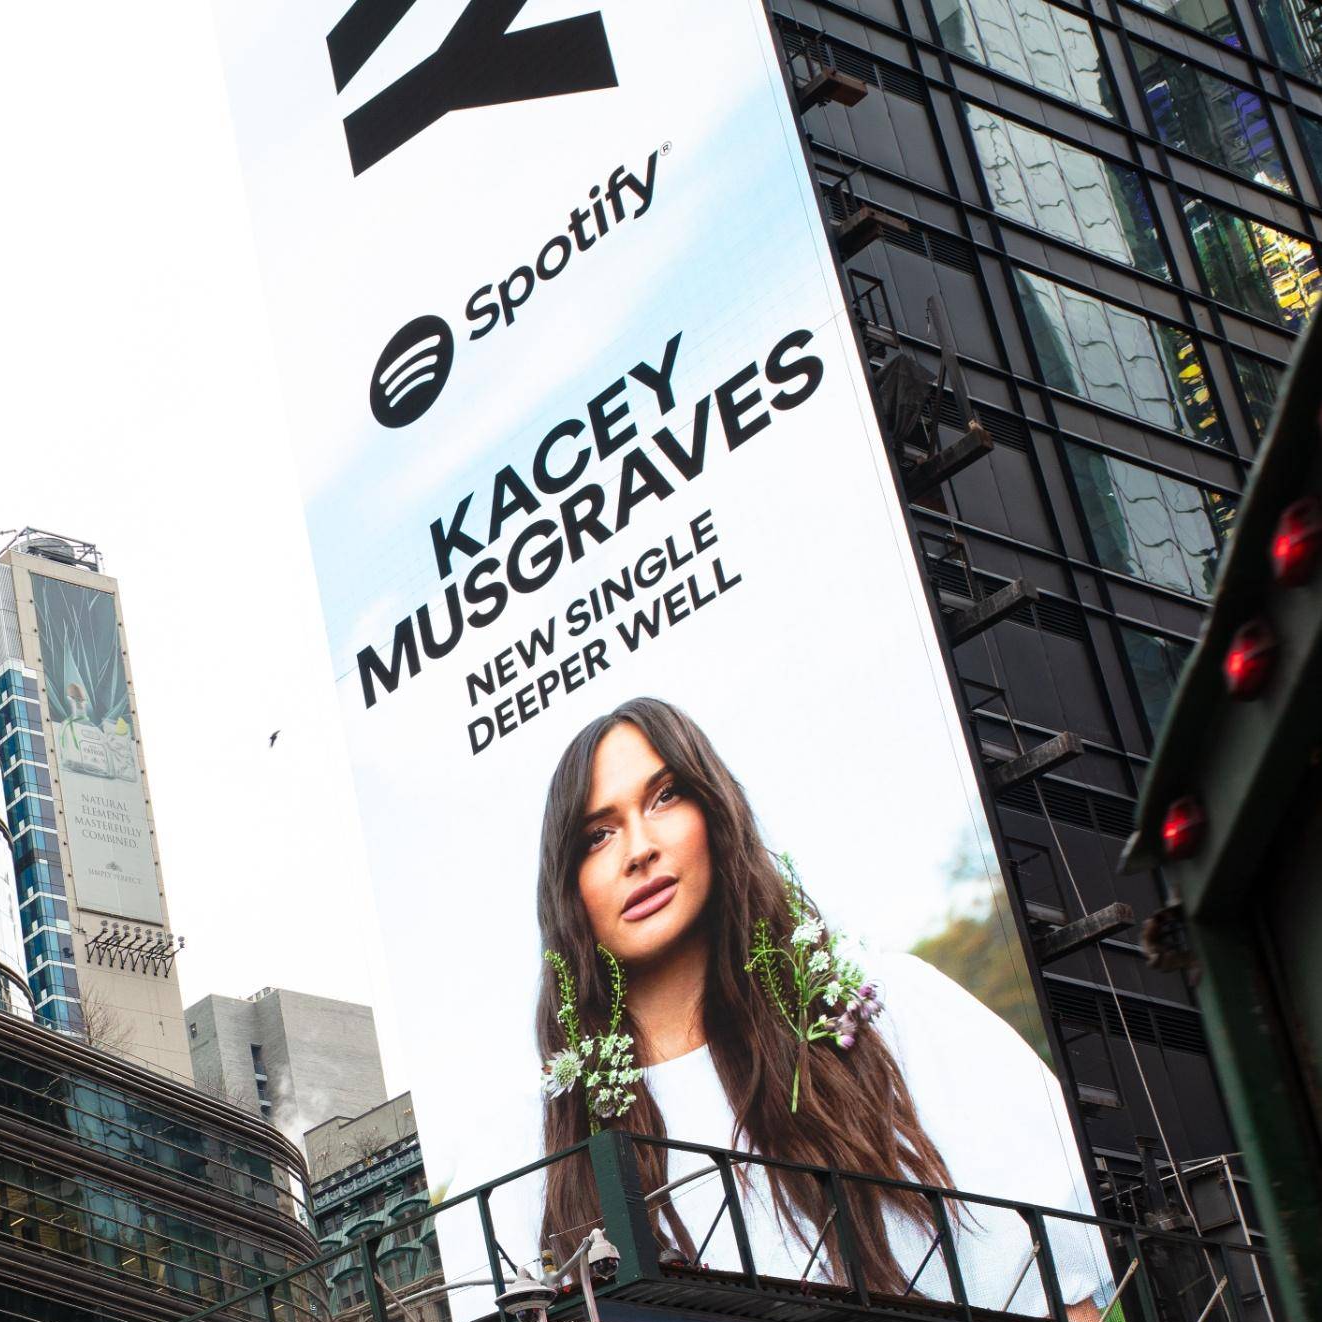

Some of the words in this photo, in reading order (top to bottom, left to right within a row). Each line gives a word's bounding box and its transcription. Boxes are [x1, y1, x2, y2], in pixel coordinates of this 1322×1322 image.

[465, 148, 659, 342] Spotify
[356, 329, 825, 710] MUSGRAVES
[429, 331, 683, 580] KACEY
[466, 616, 557, 707] NEW
[564, 509, 719, 637] SINGLE
[467, 637, 611, 756] DEEPER
[616, 559, 743, 654] WELL
[75, 816, 142, 837] MASTERFULLY
[81, 793, 129, 811] NATURAL
[82, 805, 131, 823] ELEMENTS
[82, 829, 139, 848] COMBINED.
